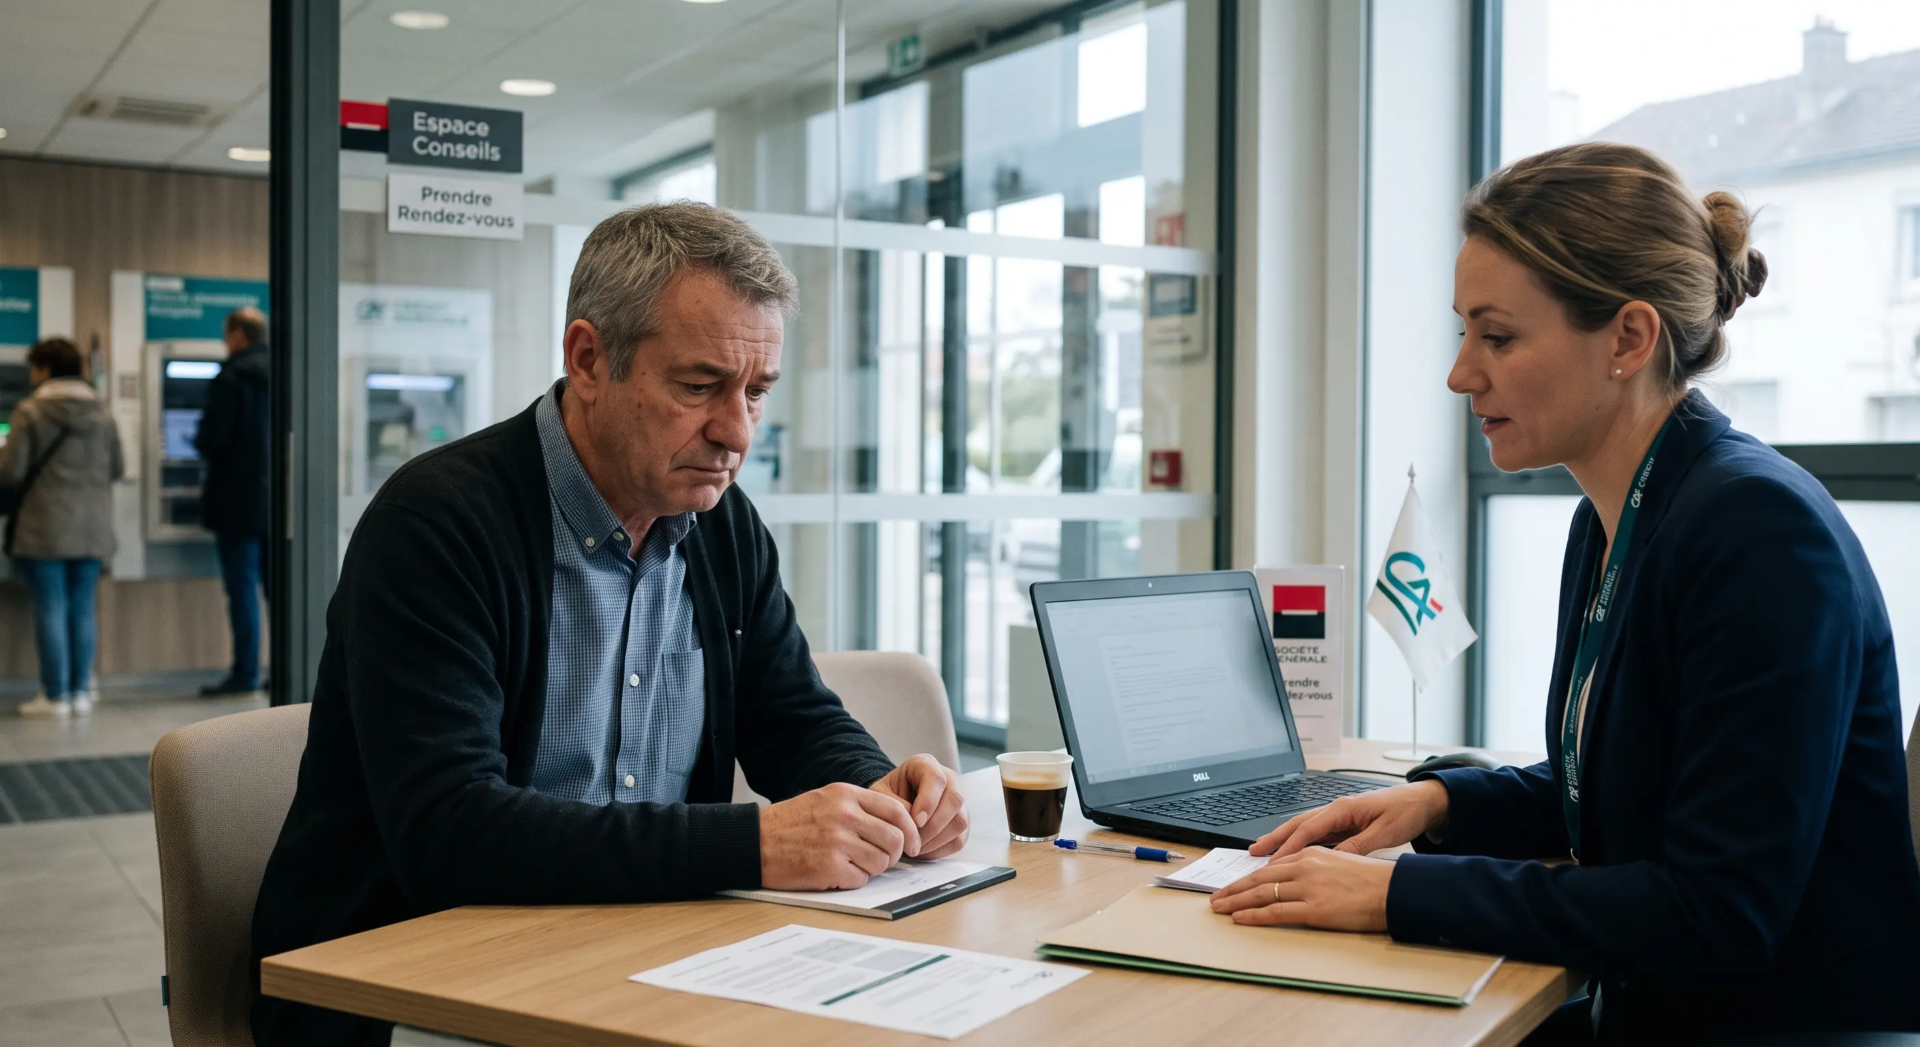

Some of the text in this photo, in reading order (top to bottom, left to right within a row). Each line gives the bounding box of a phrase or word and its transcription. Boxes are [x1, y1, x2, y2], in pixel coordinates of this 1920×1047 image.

[413, 111, 490, 137] Espace
[412, 135, 502, 162] Conseils
[421, 186, 493, 207] Prendre
[398, 205, 515, 228] Rendez-vous
[1278, 654, 1328, 664] ÉNÉRALE
[1283, 677, 1320, 688] rendre
[1287, 690, 1334, 701] dez-vous
[1192, 771, 1210, 782] DELL
